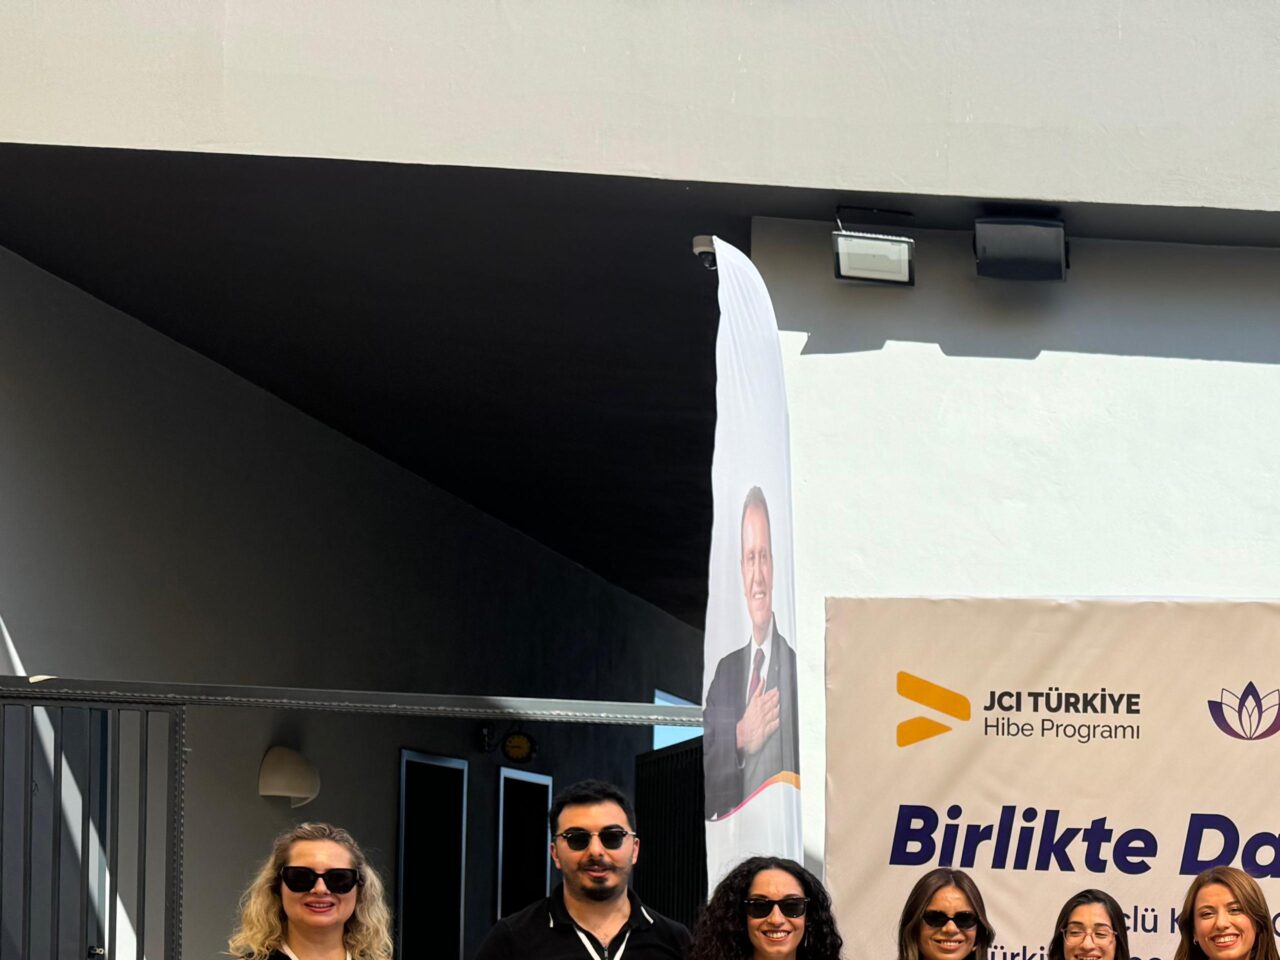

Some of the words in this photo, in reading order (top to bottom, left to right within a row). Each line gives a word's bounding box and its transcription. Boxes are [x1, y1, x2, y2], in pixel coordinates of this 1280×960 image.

[984, 690, 1022, 712] JCI
[1027, 687, 1141, 714] TÜRKİYE
[984, 717, 1034, 737] Hibe
[1041, 719, 1140, 743] Programı
[889, 804, 1158, 875] Birlikte
